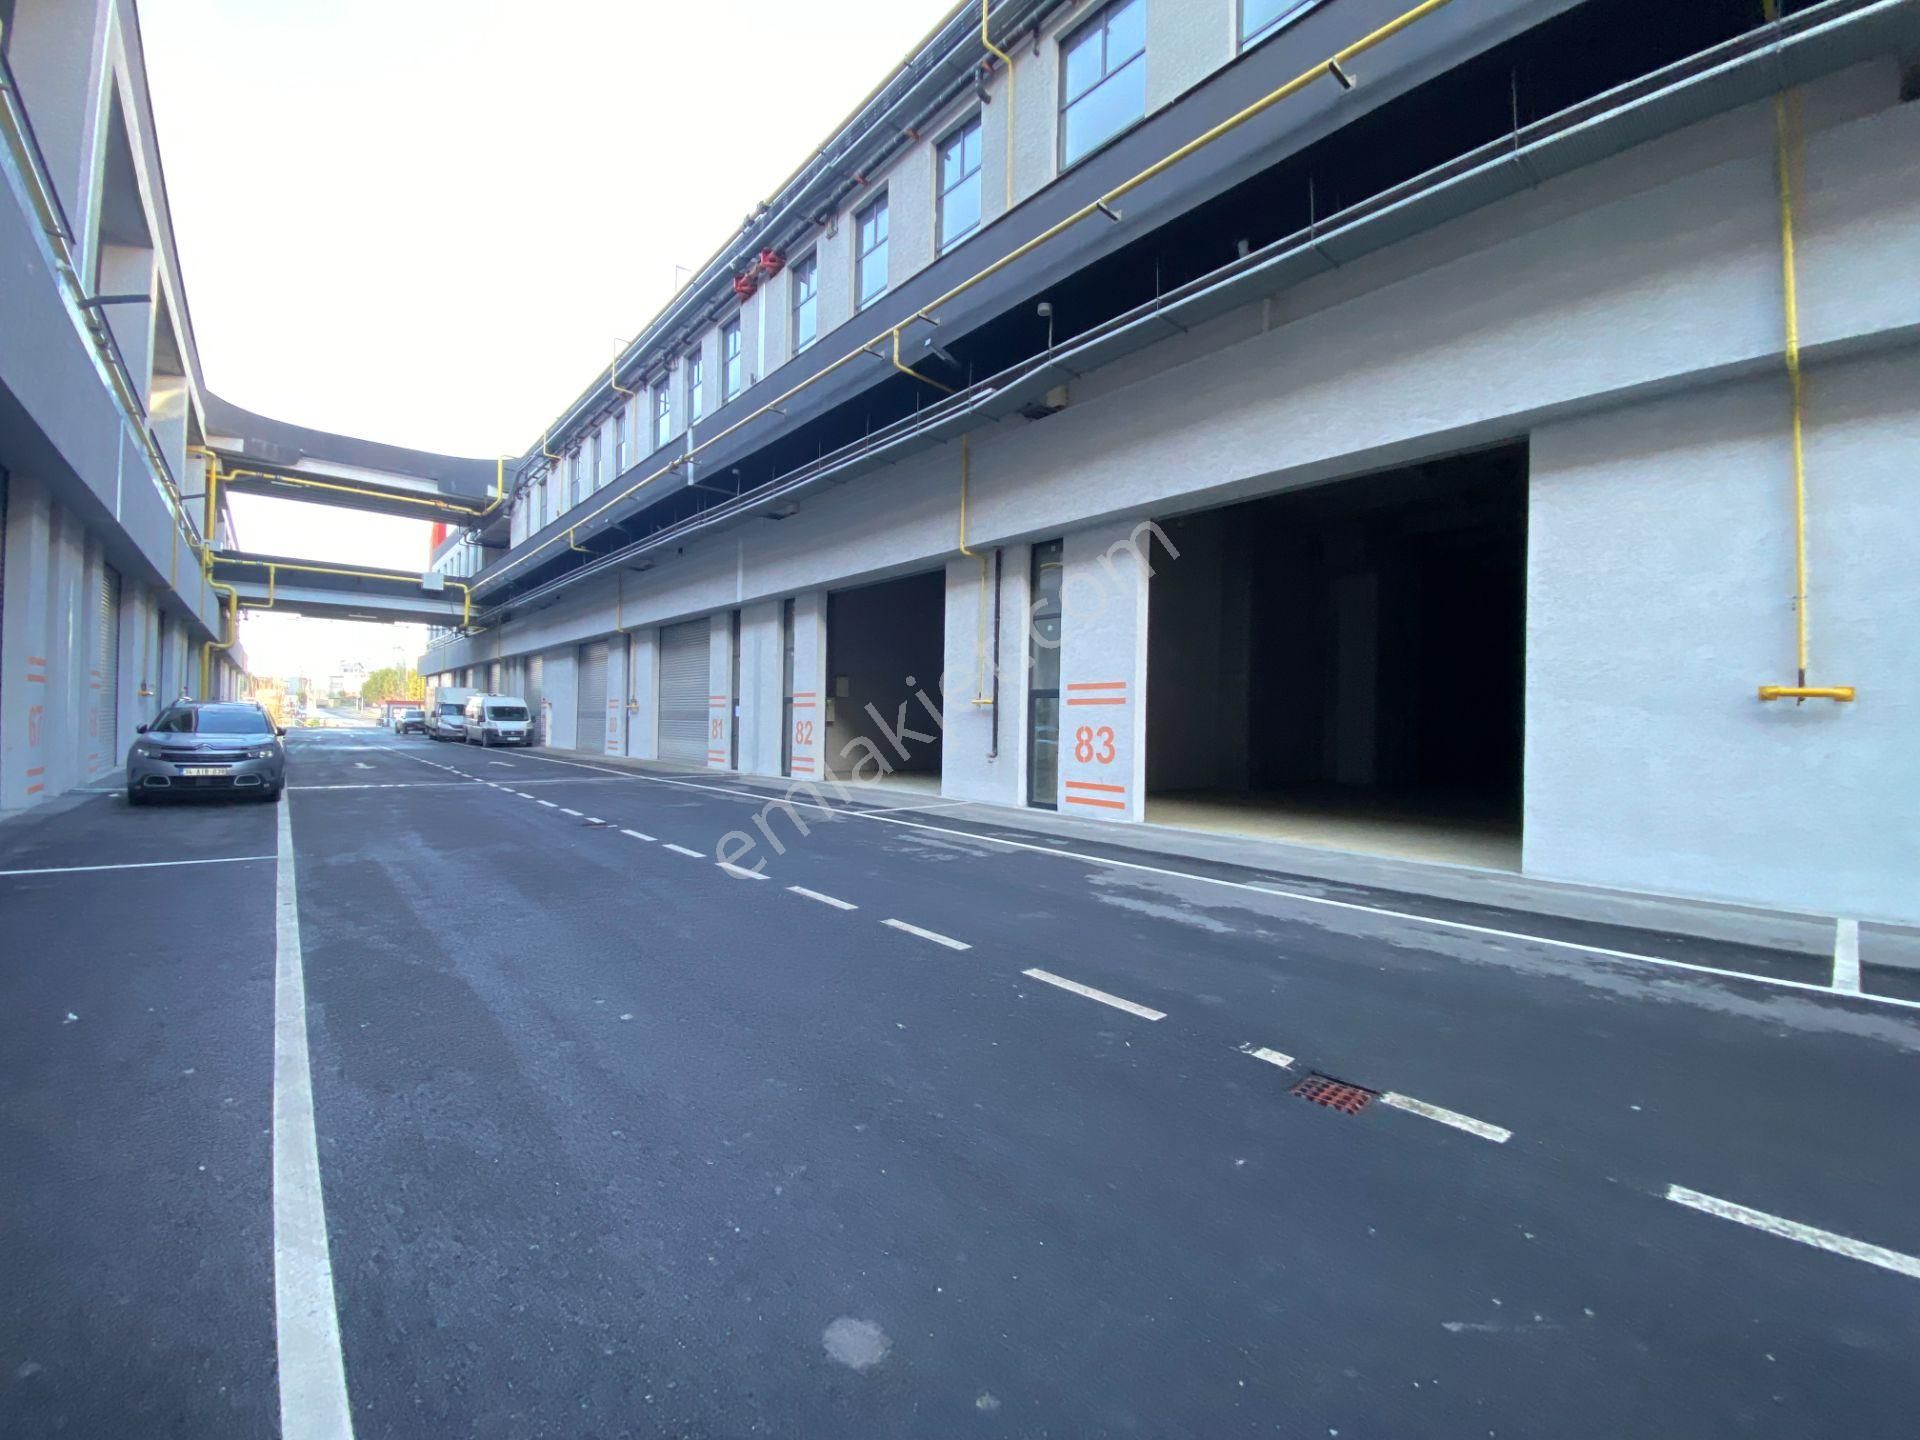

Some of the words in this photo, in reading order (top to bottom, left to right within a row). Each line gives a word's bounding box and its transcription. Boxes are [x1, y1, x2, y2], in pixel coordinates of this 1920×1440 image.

[711, 719, 723, 739] 81
[795, 720, 813, 745] 82
[1074, 726, 1115, 765] 83
